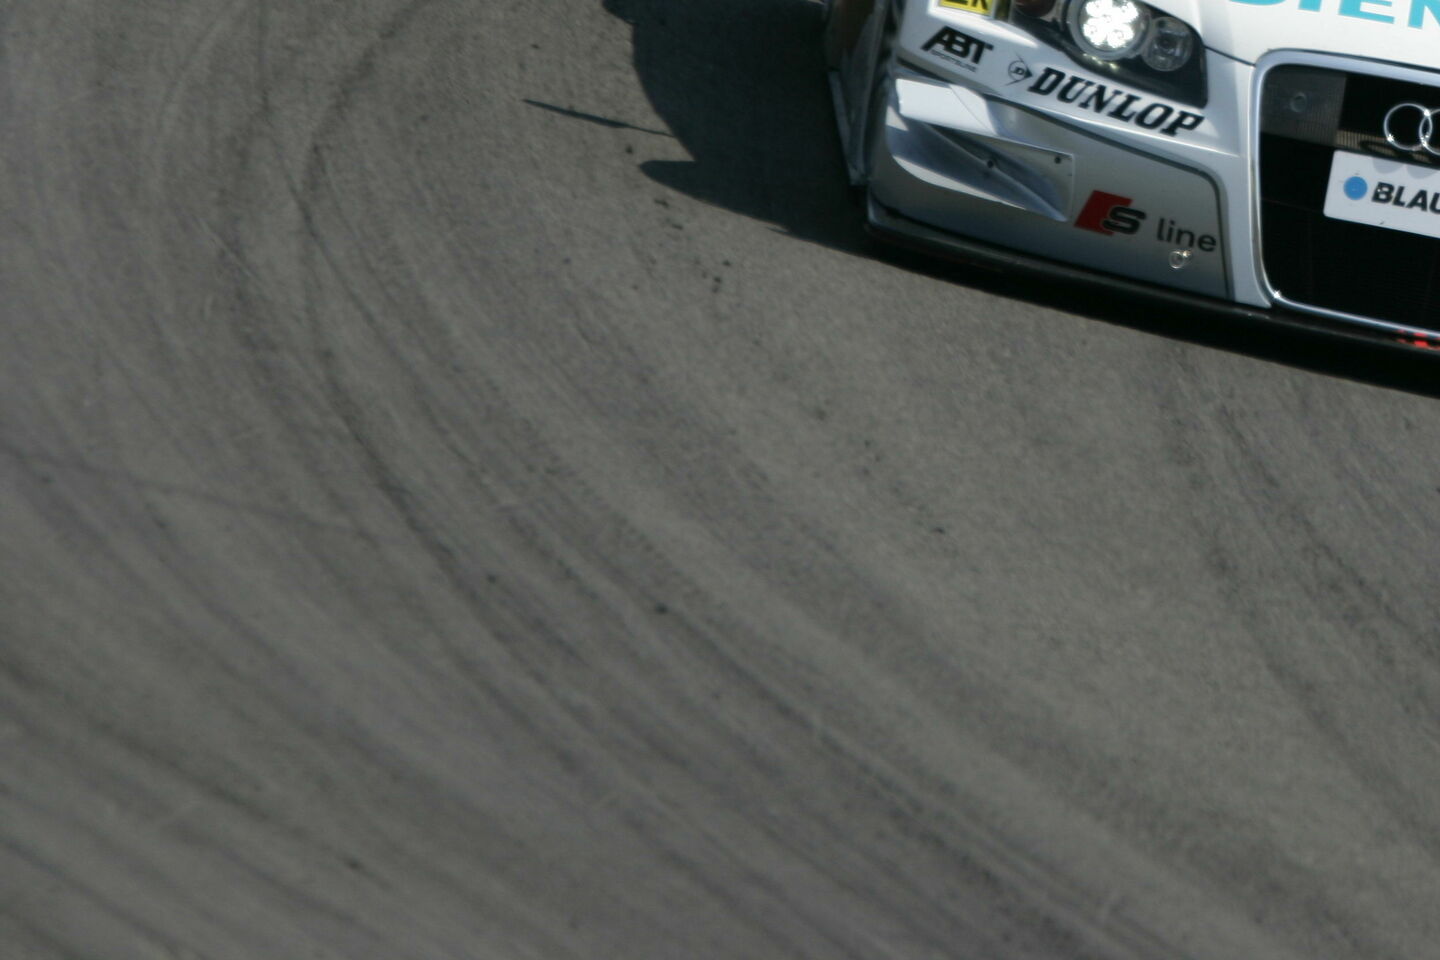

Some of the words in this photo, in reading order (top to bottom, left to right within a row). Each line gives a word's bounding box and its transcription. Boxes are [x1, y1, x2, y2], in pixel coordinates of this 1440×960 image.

[920, 25, 995, 65] ABT
[1027, 66, 1205, 138] DUNLOP
[1102, 206, 1147, 235] S
[1156, 217, 1217, 252] line
